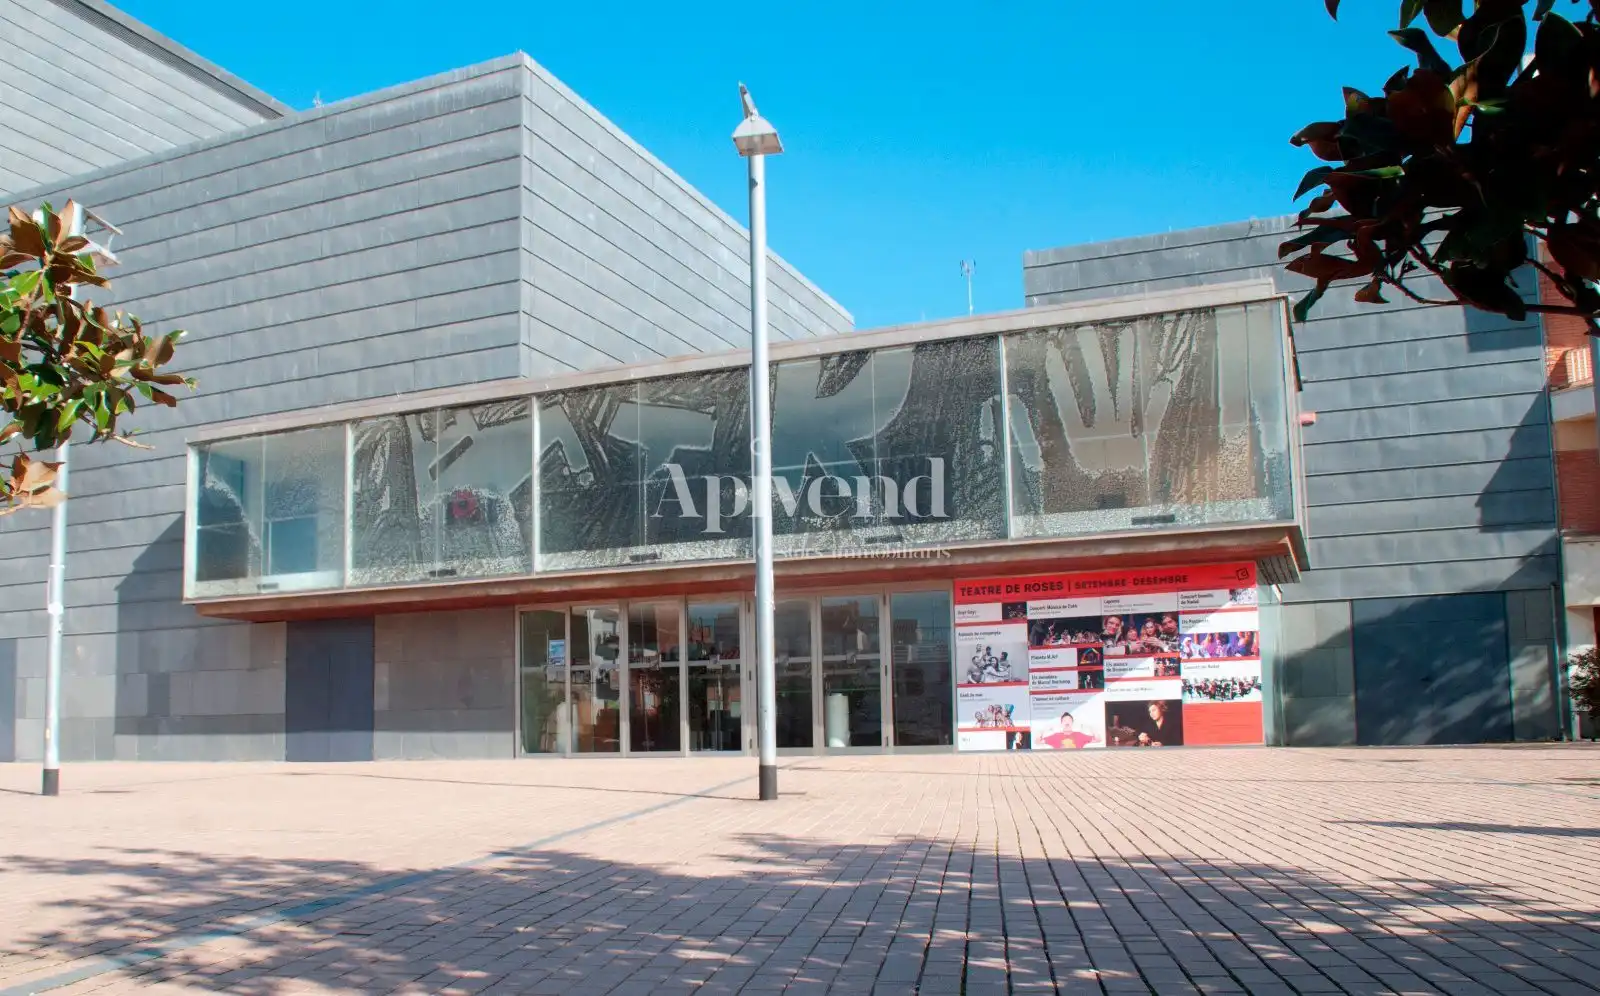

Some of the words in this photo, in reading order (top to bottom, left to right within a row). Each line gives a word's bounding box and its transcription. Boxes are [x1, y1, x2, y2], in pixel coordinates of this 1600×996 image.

[960, 585, 1001, 597] TEATRE
[1005, 583, 1021, 594] DE
[1023, 581, 1065, 593] ROSES
[1074, 578, 1127, 590] SETEMBRE
[1133, 574, 1189, 587] DESEMBRE
